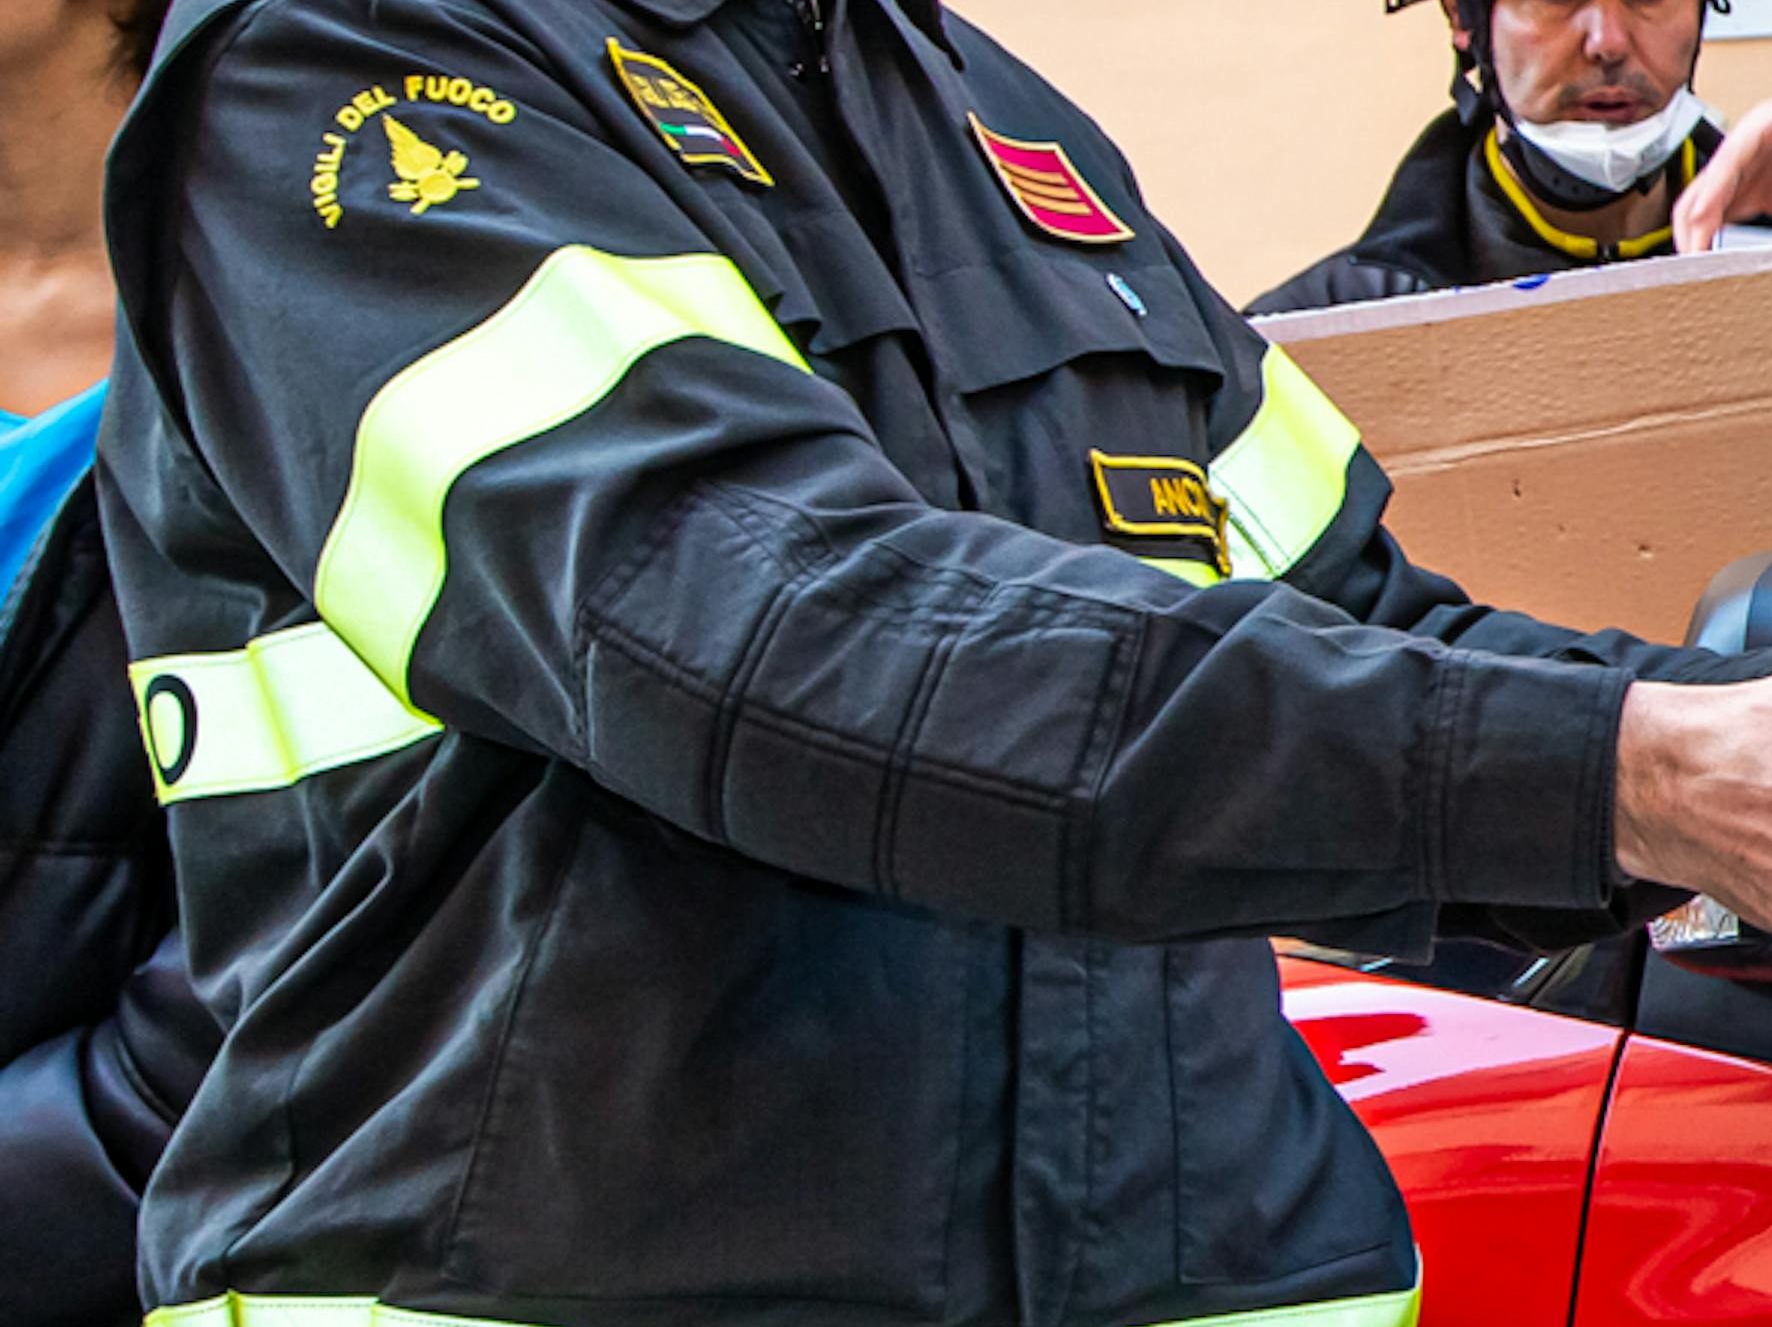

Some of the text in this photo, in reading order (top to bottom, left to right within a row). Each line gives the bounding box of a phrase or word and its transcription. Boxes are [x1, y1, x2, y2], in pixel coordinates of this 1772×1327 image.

[309, 74, 518, 230] VIGILI DEL FUOCO
